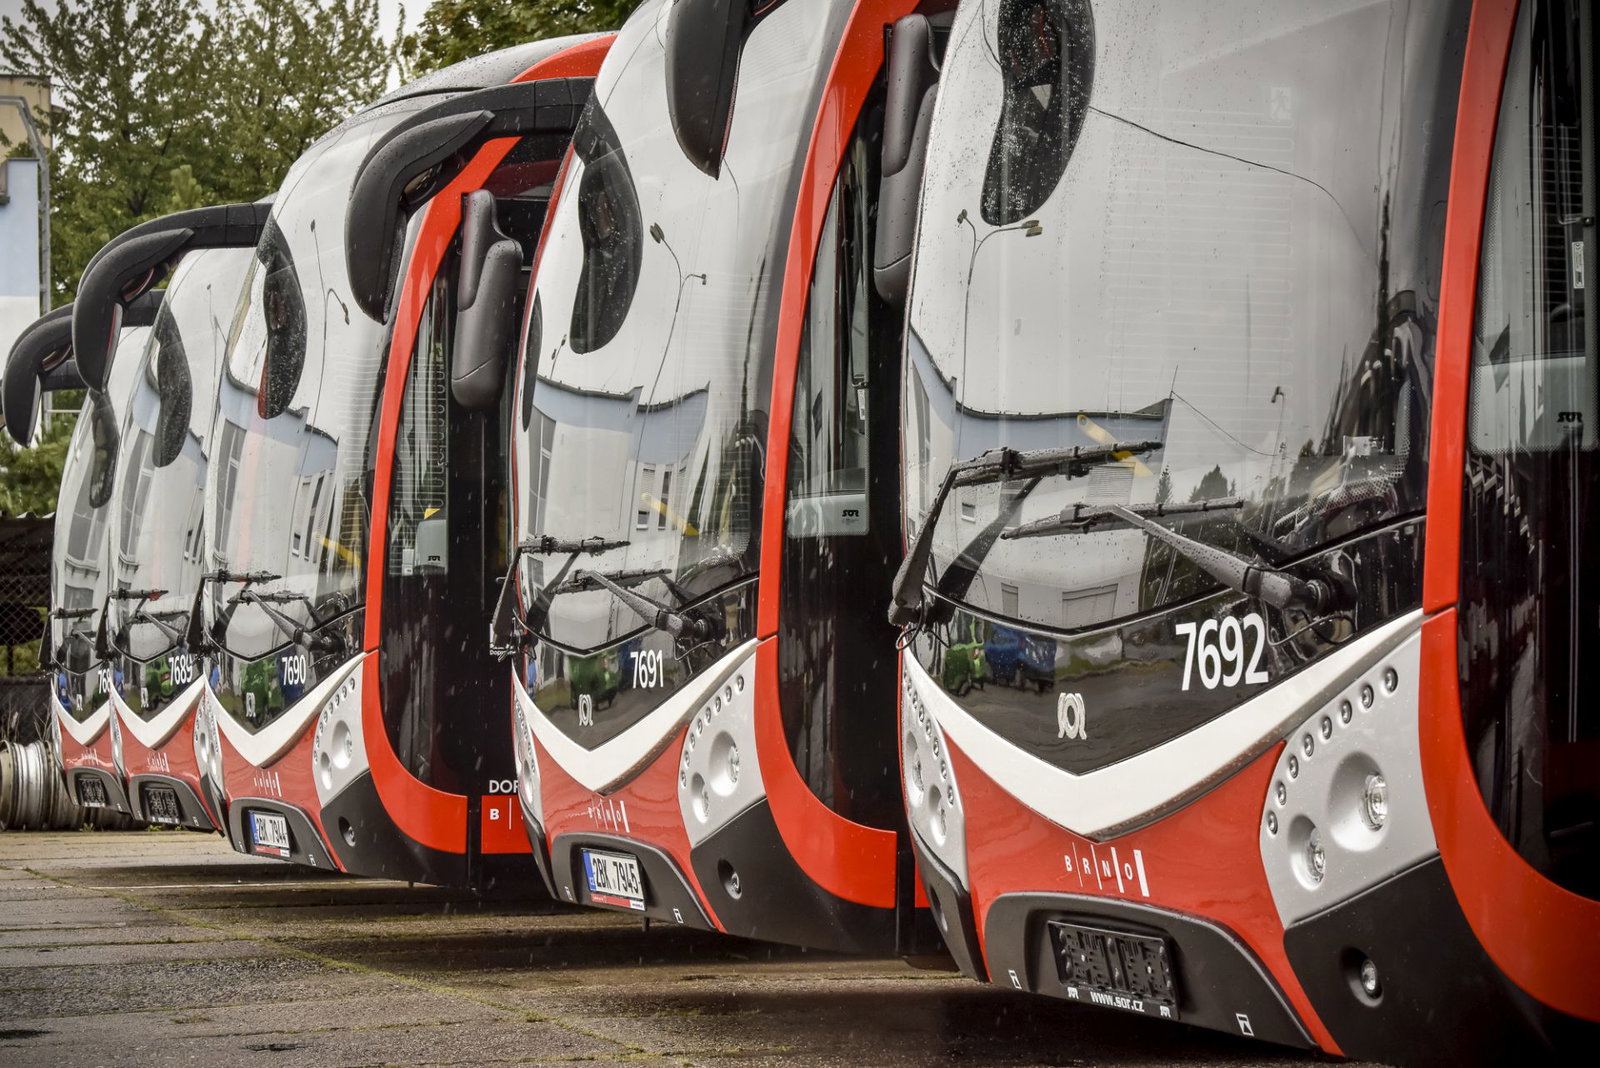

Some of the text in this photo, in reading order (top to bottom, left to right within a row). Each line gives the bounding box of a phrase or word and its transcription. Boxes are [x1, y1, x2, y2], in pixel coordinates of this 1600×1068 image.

[630, 649, 663, 688] 7691
[1175, 612, 1269, 692] 7692
[168, 653, 193, 687] 7689
[282, 654, 306, 685] 7690
[612, 860, 640, 895] 7945
[1090, 991, 1145, 1013] www.sor.cz
